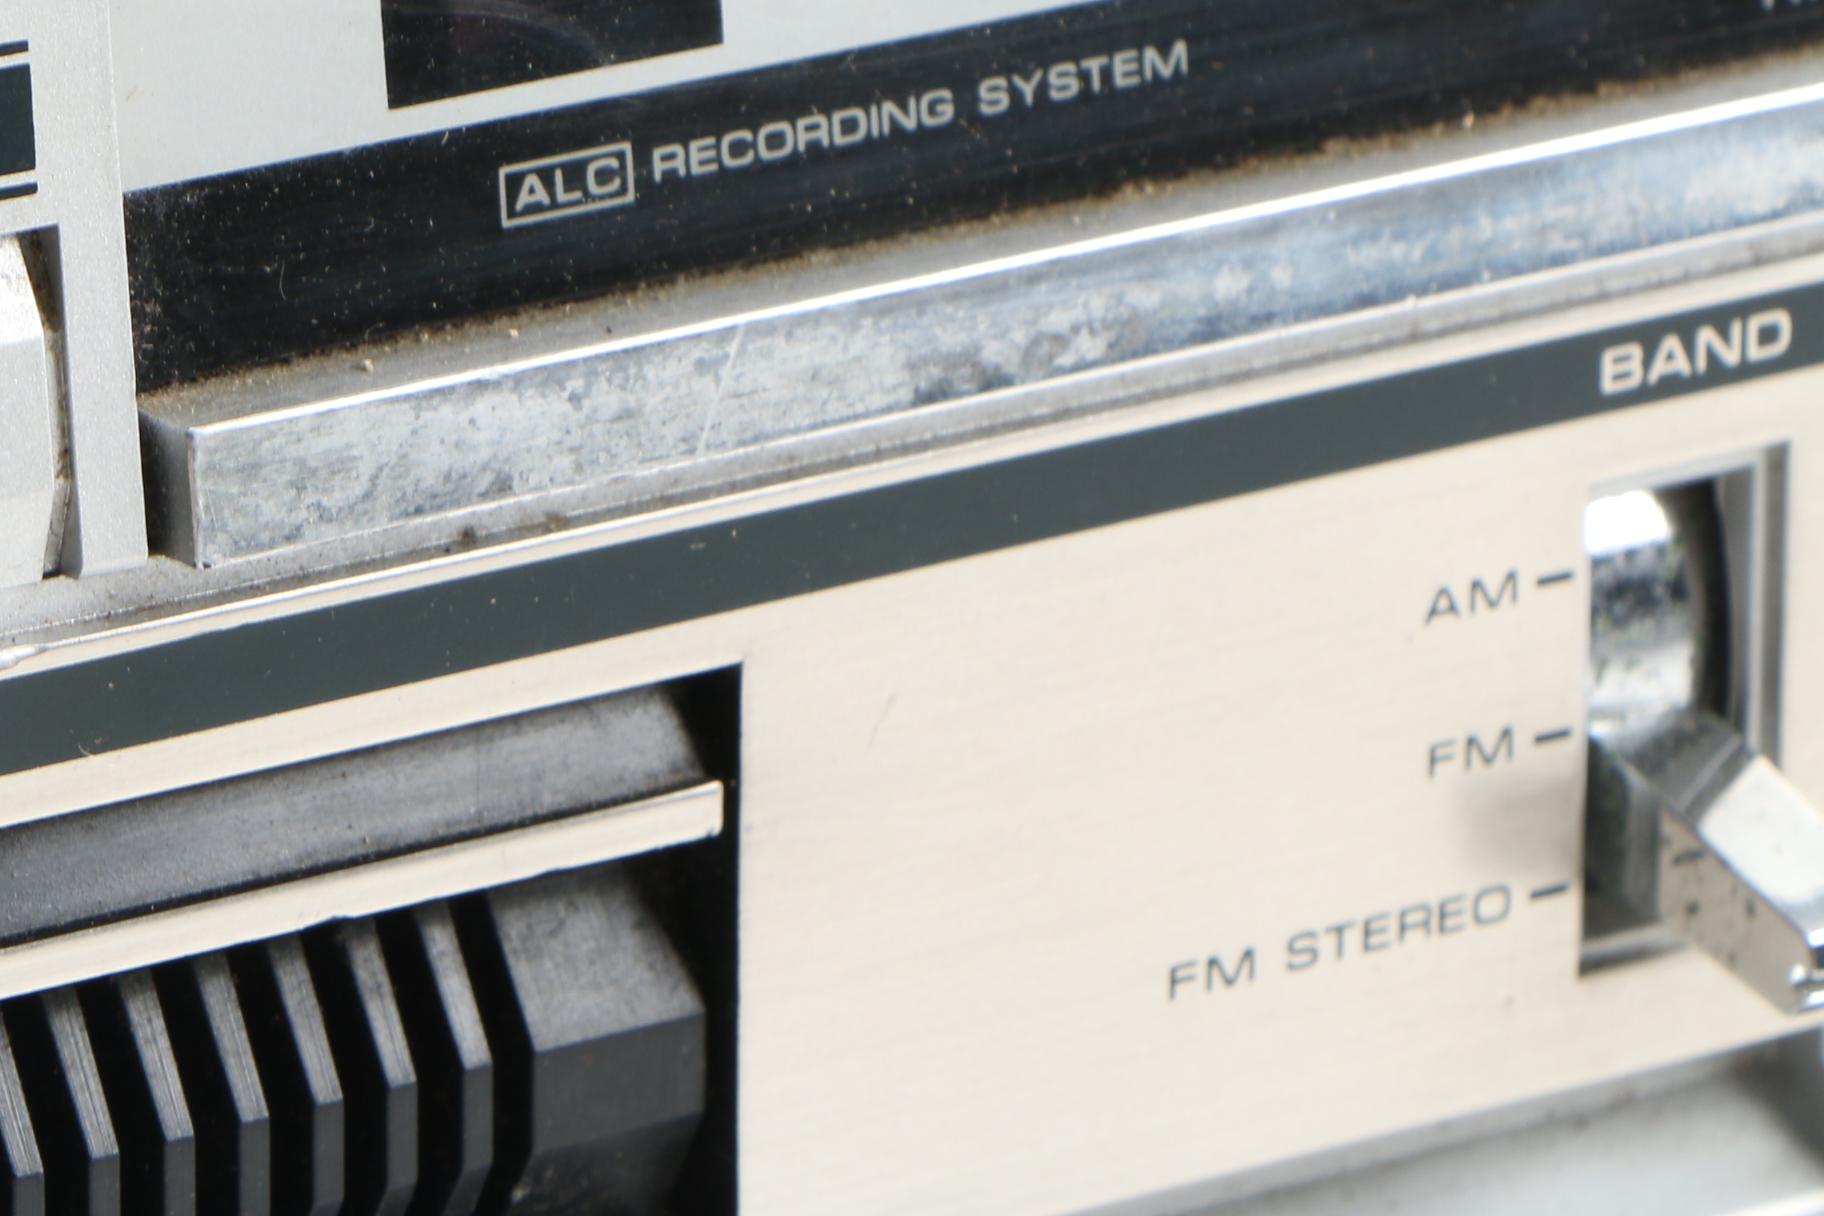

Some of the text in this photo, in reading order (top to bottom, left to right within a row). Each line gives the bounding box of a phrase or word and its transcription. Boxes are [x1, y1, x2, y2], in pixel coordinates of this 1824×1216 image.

[513, 38, 1190, 214] ALC RECORDING SYSTEM
[1598, 307, 1794, 396] BAND
[1424, 568, 1520, 625] AM
[1426, 724, 1514, 778] FM
[1167, 882, 1512, 1001] FM STEREO
